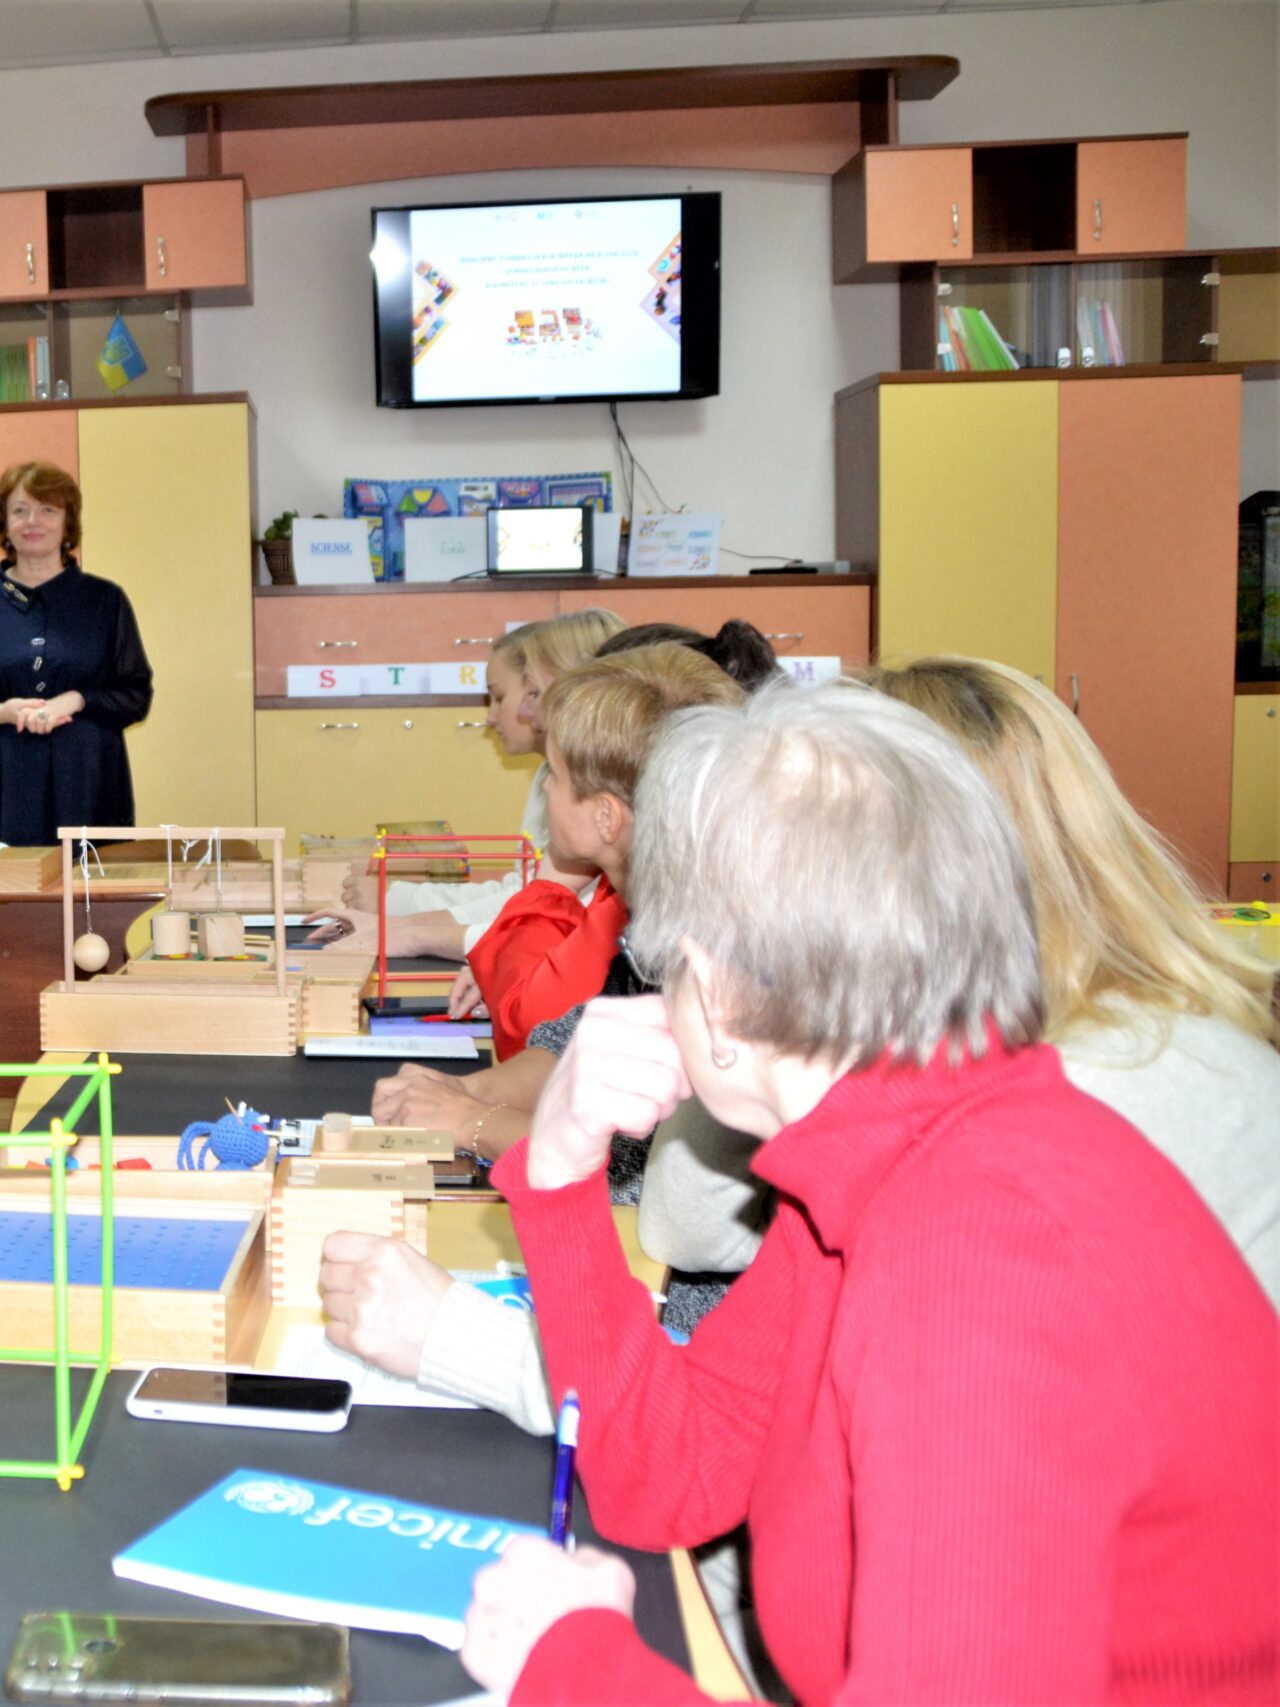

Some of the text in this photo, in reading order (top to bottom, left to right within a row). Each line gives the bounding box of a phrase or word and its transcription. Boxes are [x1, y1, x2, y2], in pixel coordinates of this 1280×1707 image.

[310, 541, 353, 554] SCIENSE
[319, 661, 816, 689] S T R M
